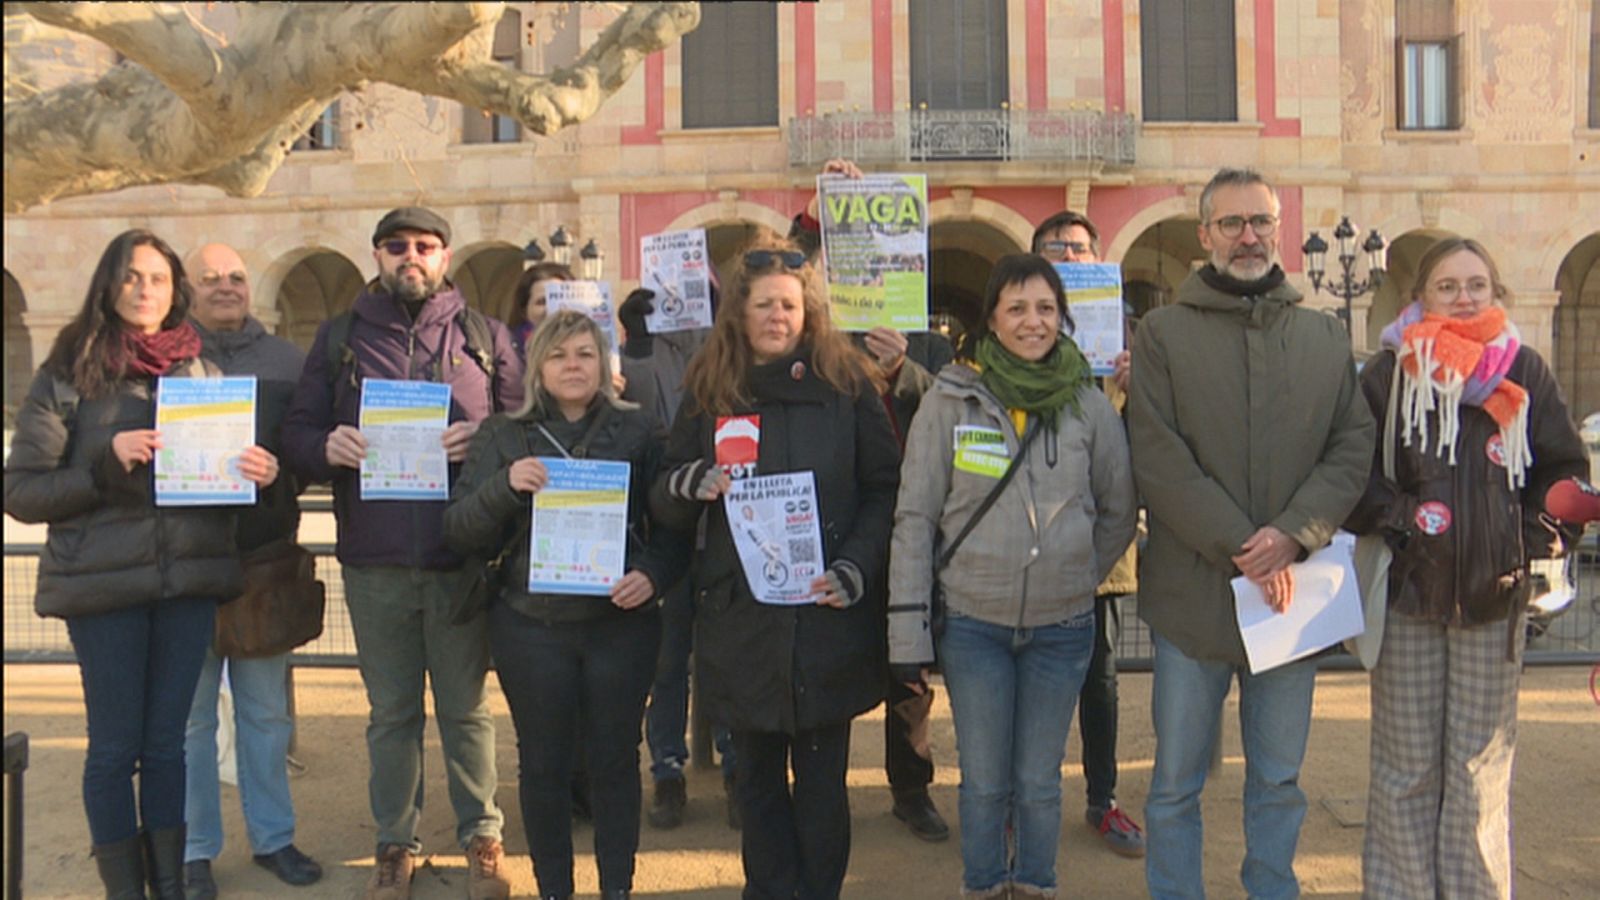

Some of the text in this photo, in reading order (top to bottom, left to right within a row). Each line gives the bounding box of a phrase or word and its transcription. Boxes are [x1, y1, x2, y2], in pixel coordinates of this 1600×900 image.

[827, 194, 920, 224] VAGA
[743, 480, 757, 490] EN
[730, 492, 749, 501] PER
[751, 491, 764, 500] LA
